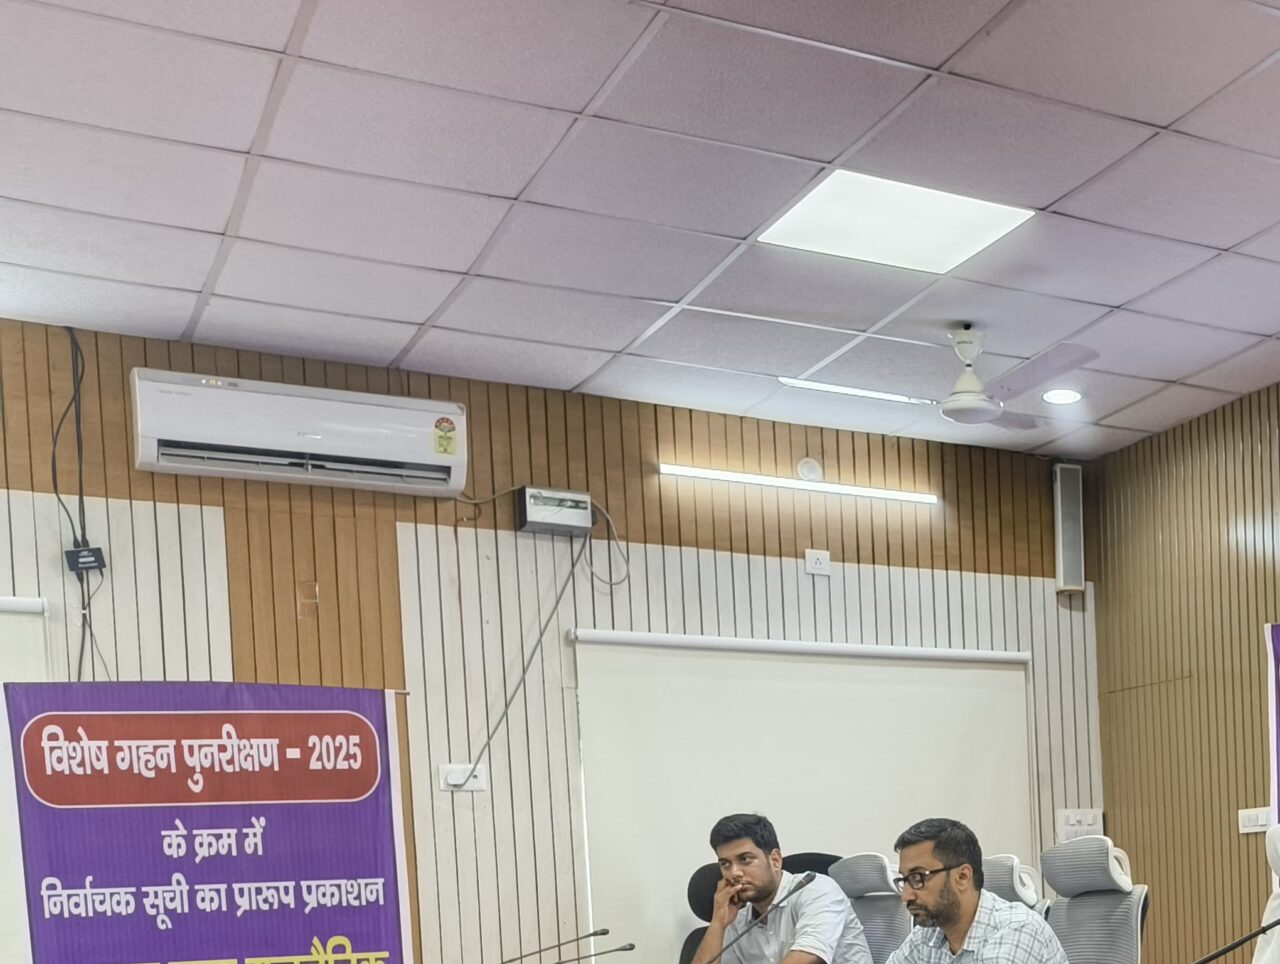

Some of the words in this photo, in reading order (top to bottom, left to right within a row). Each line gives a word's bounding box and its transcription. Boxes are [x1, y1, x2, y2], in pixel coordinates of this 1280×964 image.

[40, 725, 109, 775] विशेष
[114, 739, 176, 778] गहन
[182, 724, 280, 793] पुनरीक्षण
[308, 735, 362, 770] 2025
[161, 819, 188, 858] के
[193, 828, 238, 863] क्रम
[243, 817, 267, 856] में
[41, 876, 137, 919] निर्वाचक
[142, 872, 190, 930] सूची
[194, 883, 228, 913] का
[232, 880, 296, 917] प्रारूप
[300, 877, 386, 914] प्रकाशन
